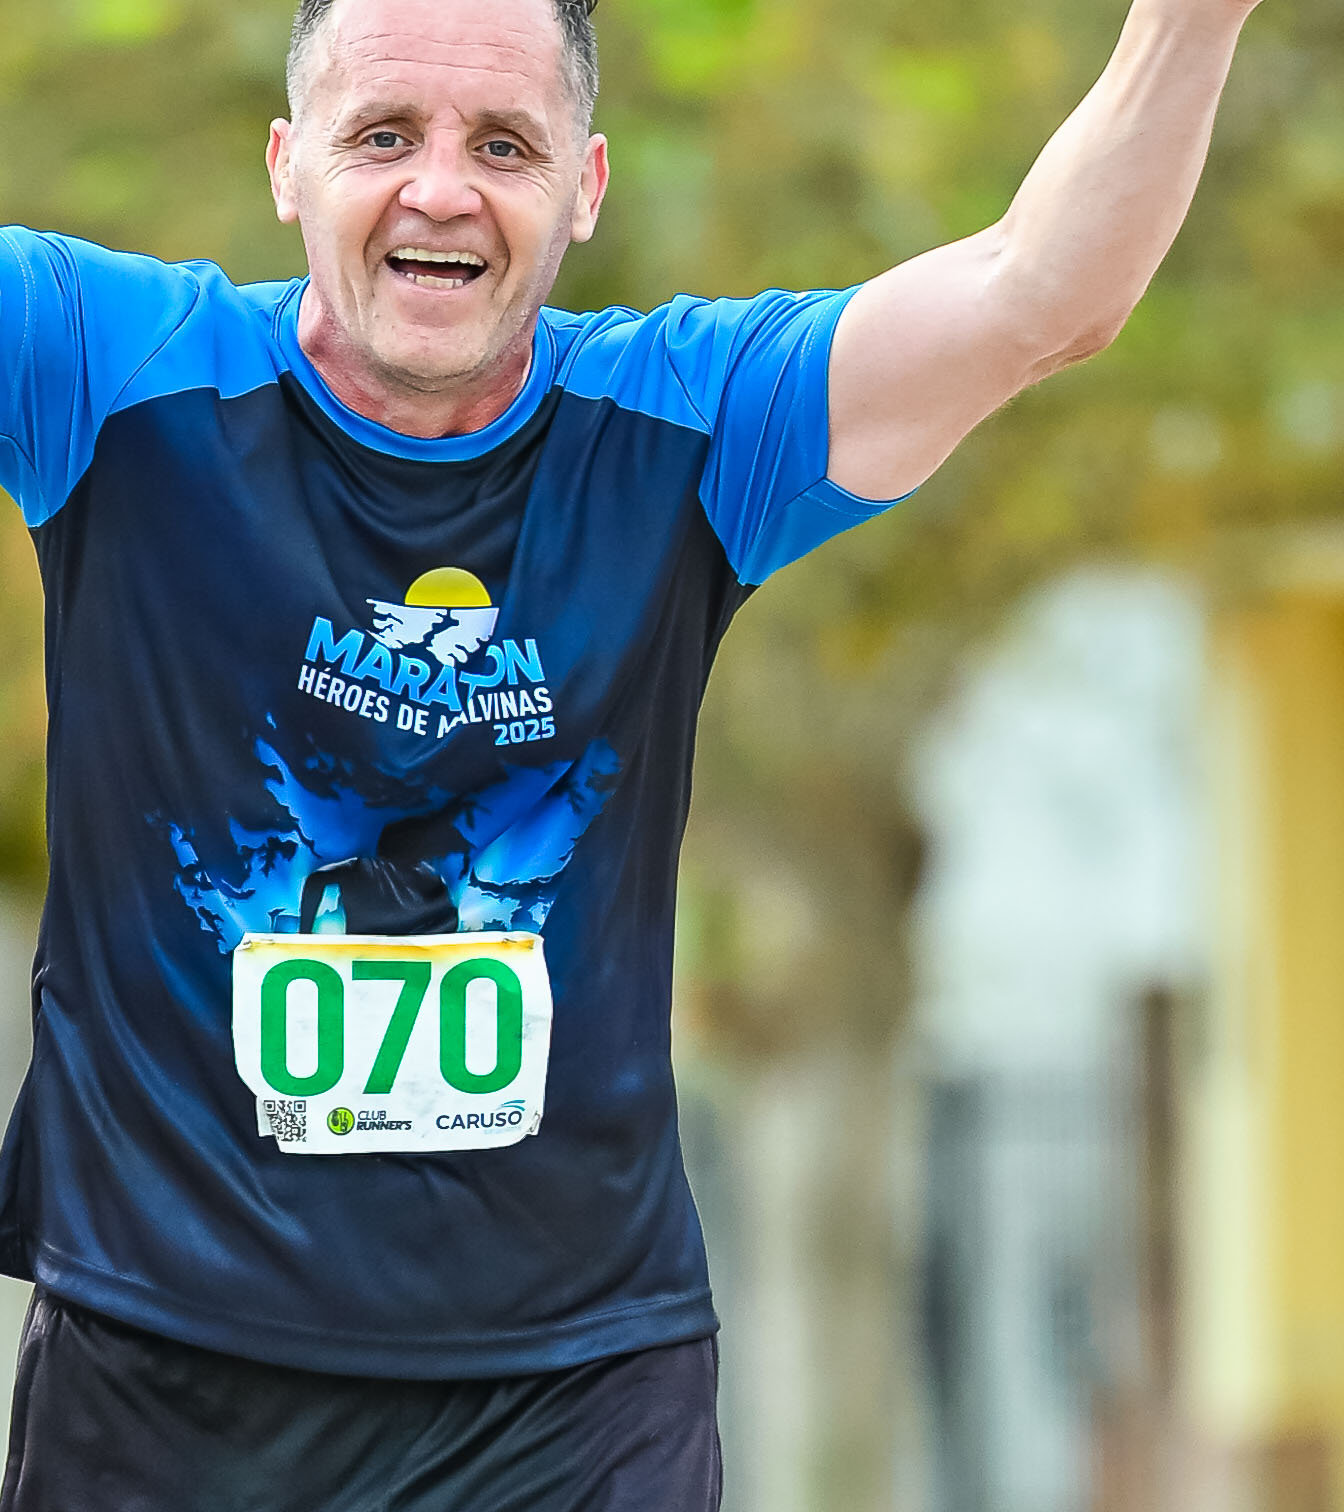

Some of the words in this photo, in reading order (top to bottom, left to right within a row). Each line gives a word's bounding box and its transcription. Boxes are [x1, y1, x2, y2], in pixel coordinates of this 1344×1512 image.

[297, 665, 390, 723] HÉROES
[396, 703, 429, 736] DE
[493, 716, 555, 746] 2025
[260, 958, 523, 1097] 070
[356, 1120, 413, 1131] RUNNER'S
[357, 1110, 387, 1121] CLUB
[435, 1110, 522, 1130] CARUSO
